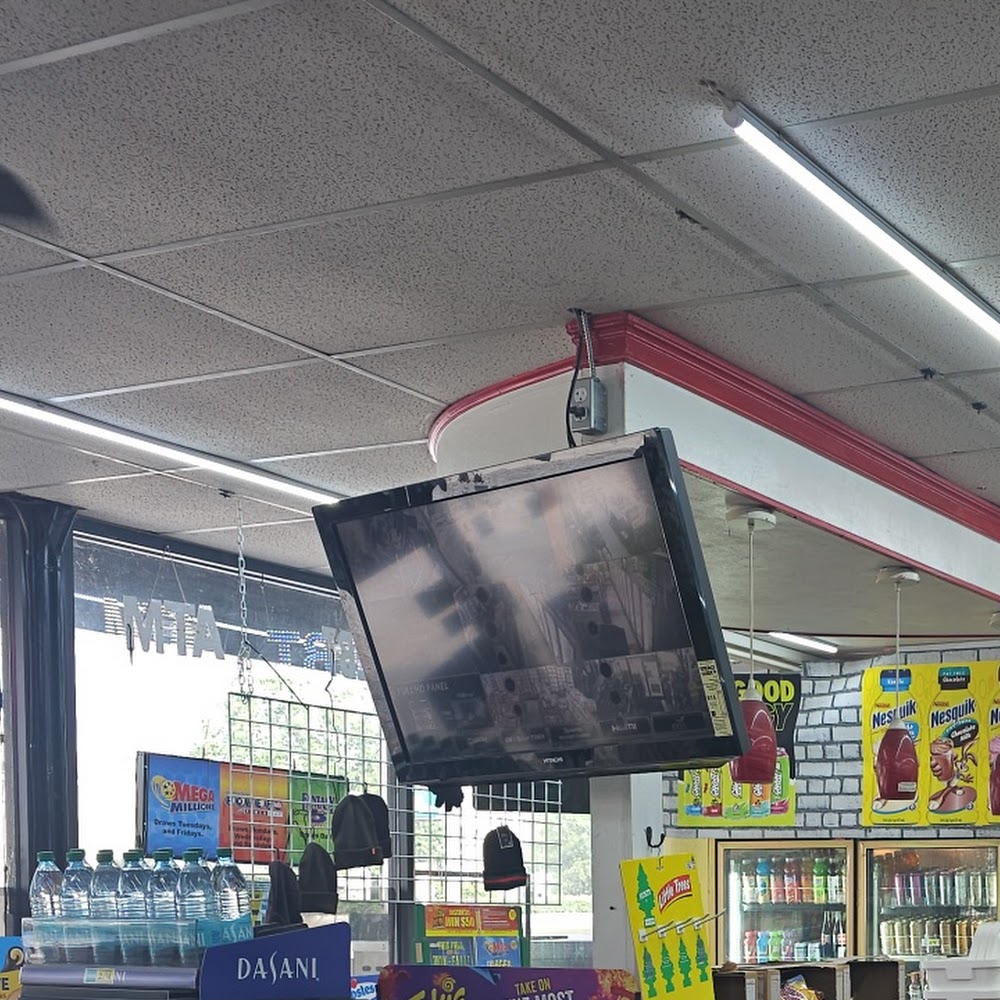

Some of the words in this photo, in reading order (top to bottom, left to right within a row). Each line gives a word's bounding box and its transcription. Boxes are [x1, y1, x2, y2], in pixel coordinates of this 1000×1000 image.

[930, 698, 976, 729] Nesquik
[173, 781, 214, 802] MEGA
[238, 951, 320, 986] DASANI
[514, 979, 537, 995] TAKE
[538, 977, 551, 992] ON
